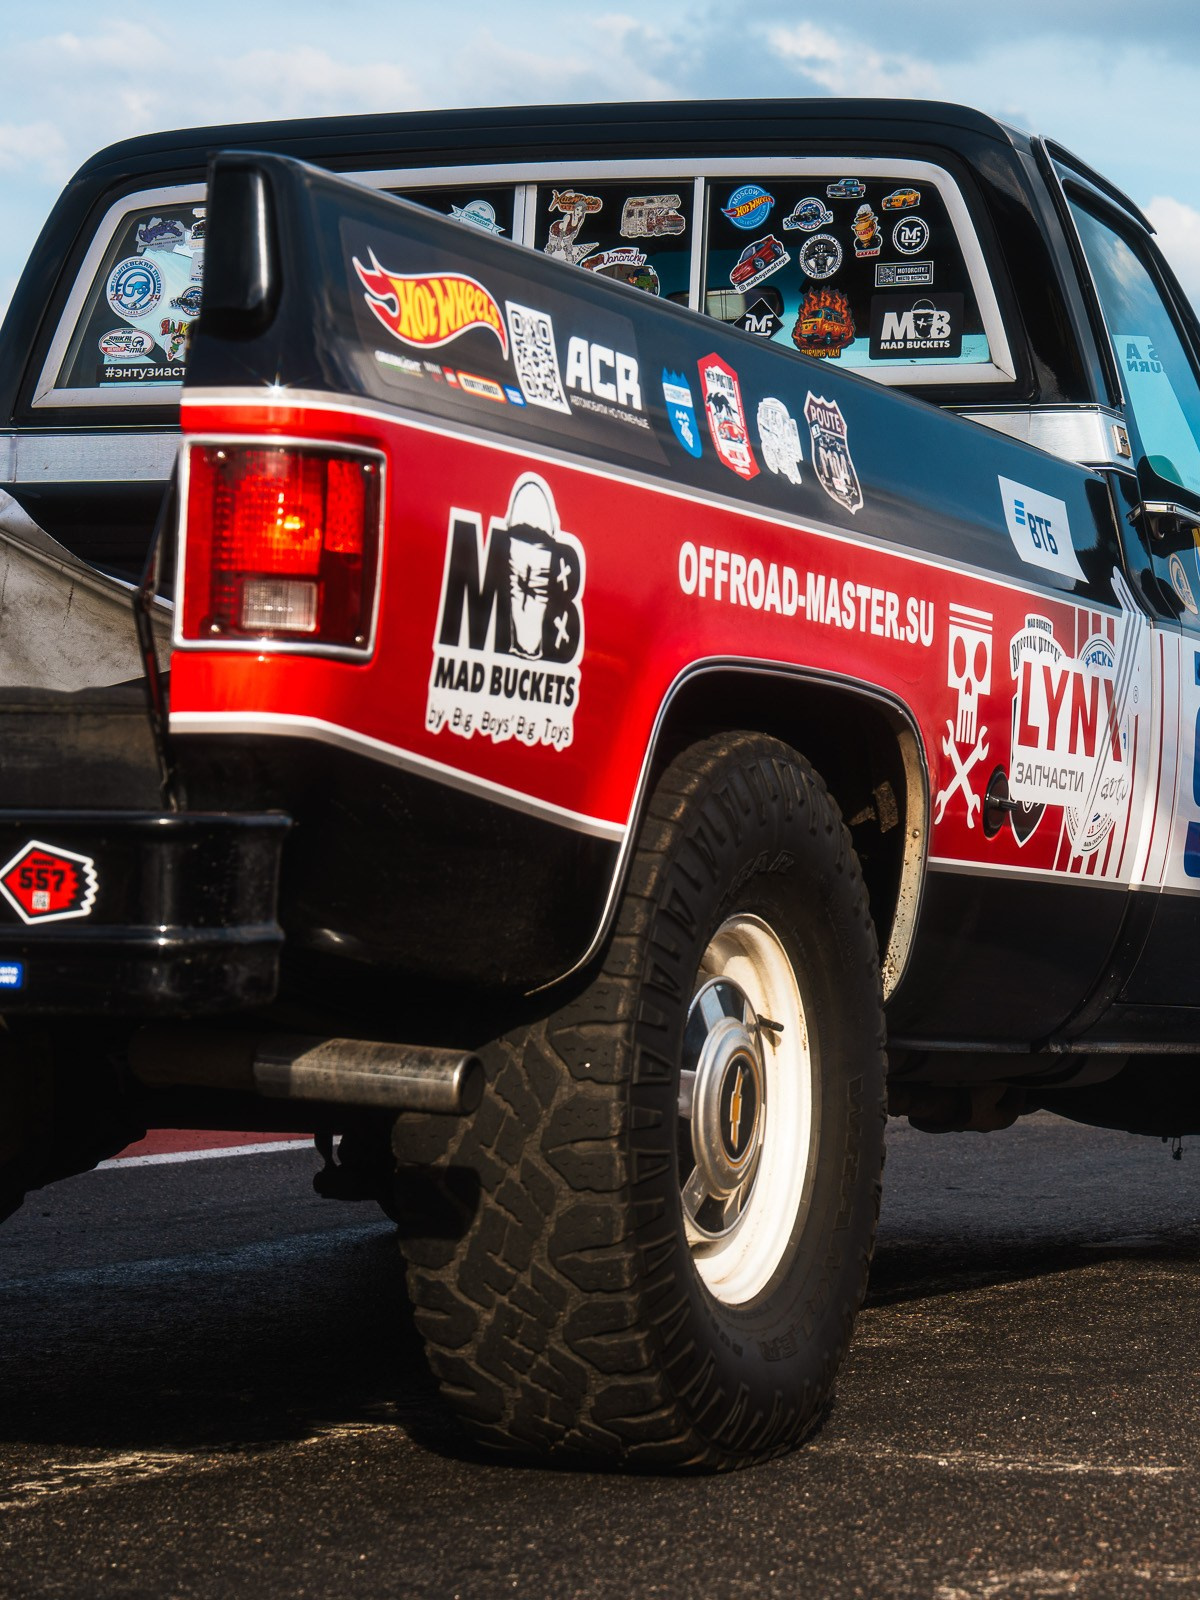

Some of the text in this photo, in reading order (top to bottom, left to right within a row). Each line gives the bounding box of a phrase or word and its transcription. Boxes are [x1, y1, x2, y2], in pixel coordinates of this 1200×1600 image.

[732, 188, 760, 205] MOSCOW
[602, 250, 646, 266] Vanarchy
[387, 278, 501, 341] HOT WHEELS
[880, 340, 950, 349] MAD BUCKETS
[810, 404, 842, 433] ROUTE
[1028, 512, 1058, 555] ВТБ
[678, 541, 934, 647] OFFROAD-MASTER.SU
[433, 656, 576, 707] MAD BUCKETS
[428, 703, 445, 729] by
[453, 707, 473, 732] Big
[517, 715, 536, 740] Big
[544, 717, 570, 743] Toys
[1015, 762, 1084, 793] ЗАПЧАСТИ
[19, 866, 66, 892] 557
